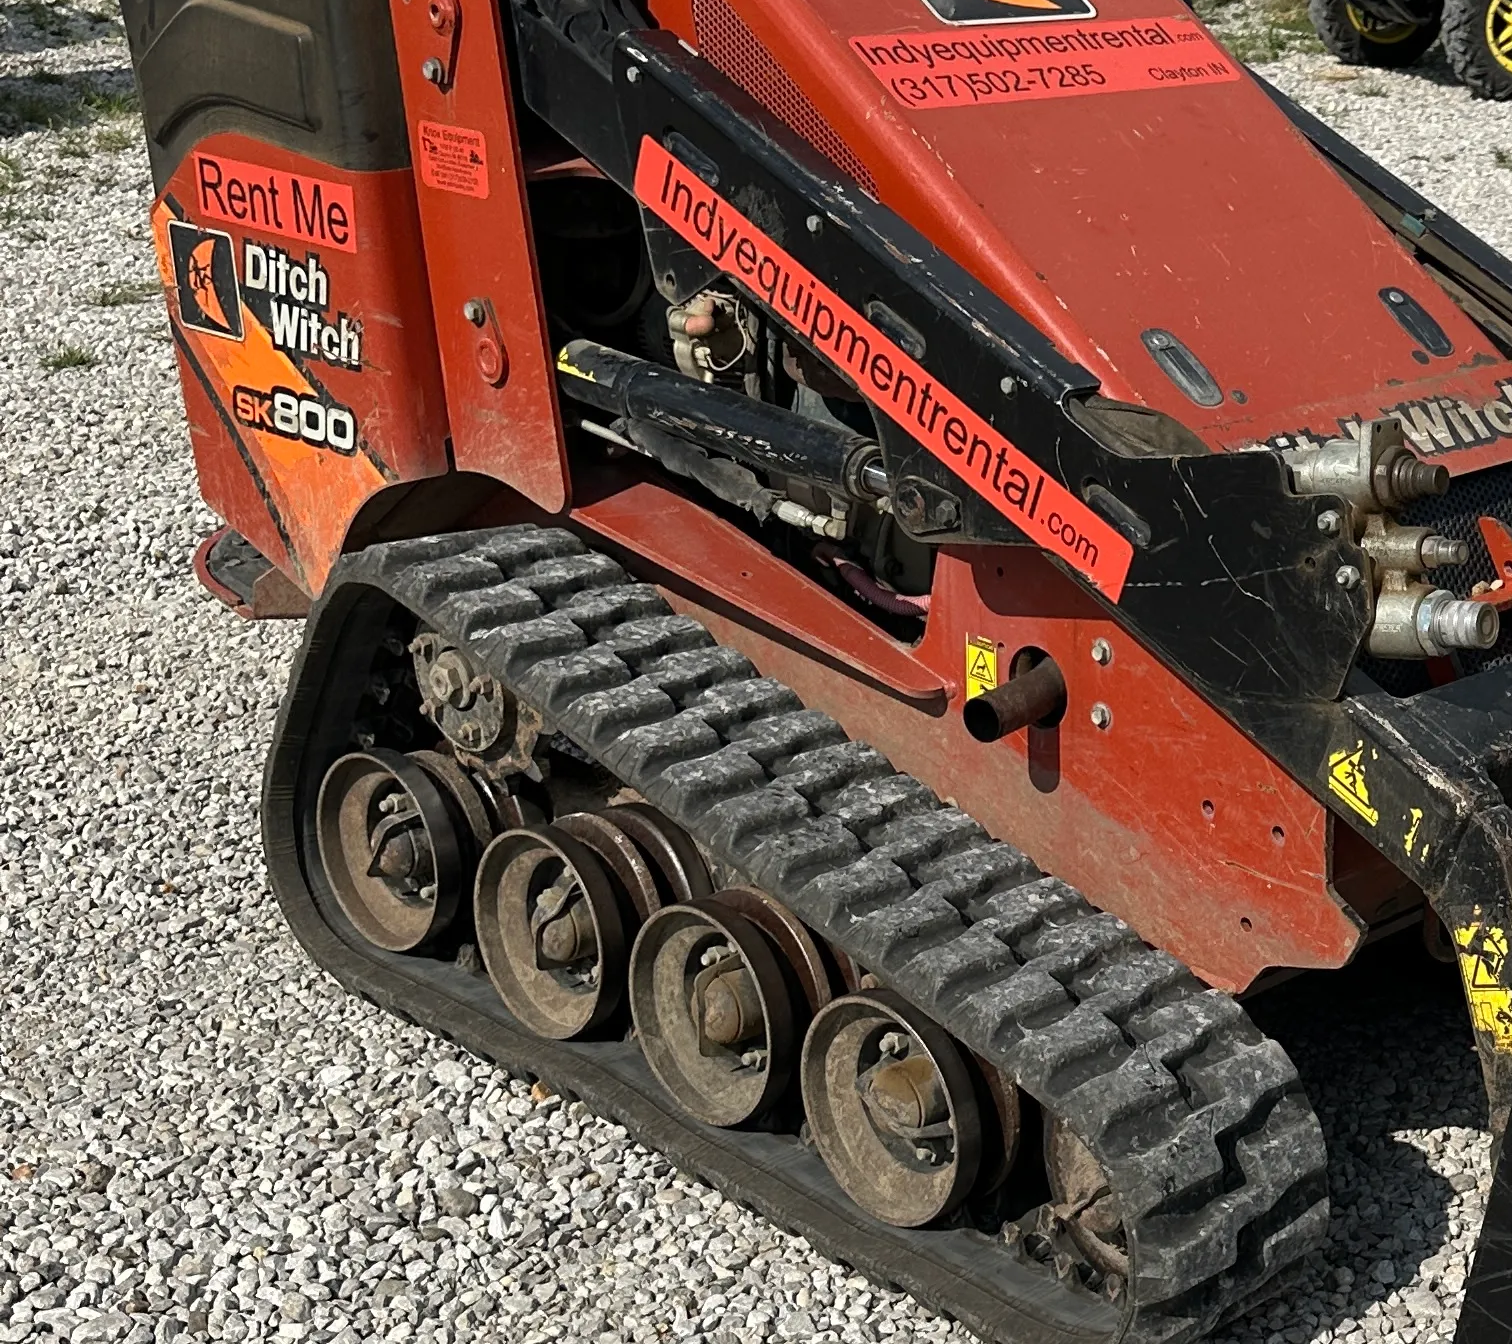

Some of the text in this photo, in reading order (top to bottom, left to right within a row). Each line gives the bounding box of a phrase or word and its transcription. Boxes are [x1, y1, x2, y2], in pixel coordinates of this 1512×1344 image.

[891, 63, 1106, 107] (317)502-7285
[1148, 62, 1230, 82] Clayton IN
[198, 158, 349, 245] Rent Me
[245, 244, 327, 306] Ditch
[271, 301, 361, 365] Witch
[236, 391, 354, 450] SK800
